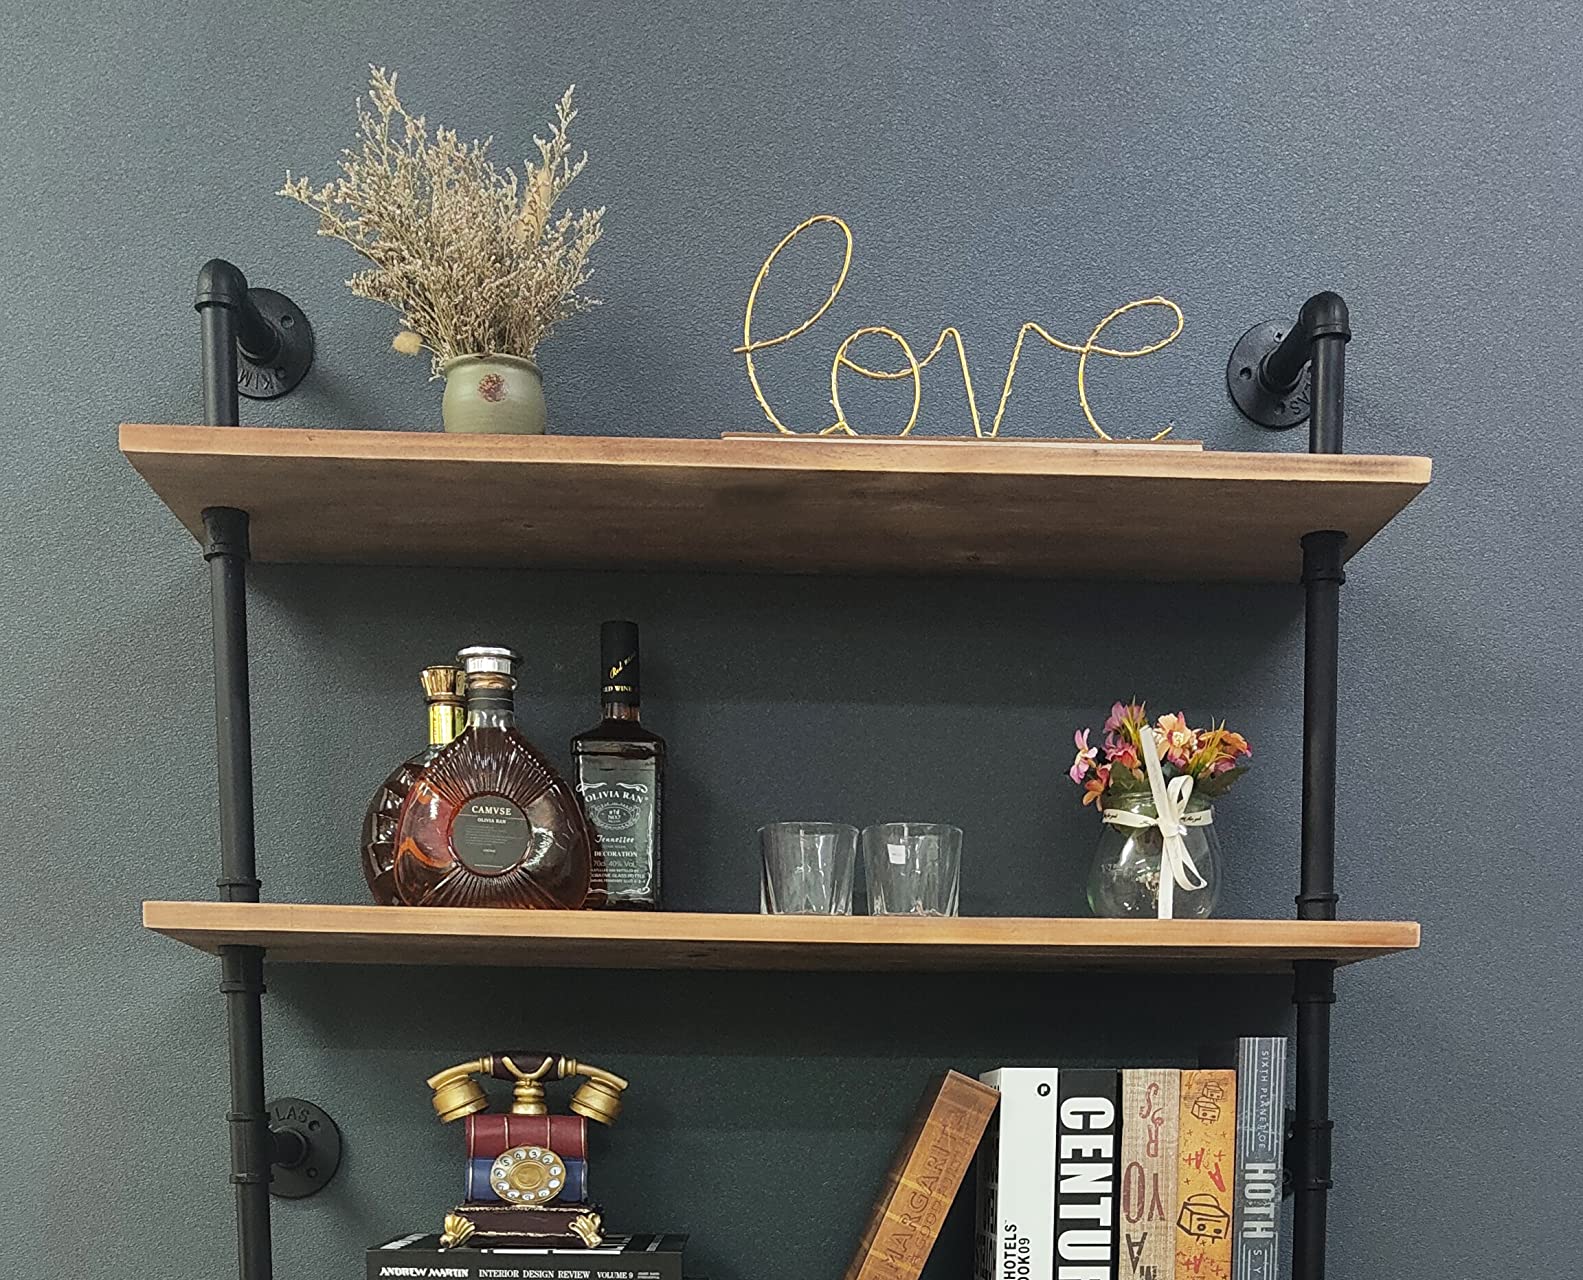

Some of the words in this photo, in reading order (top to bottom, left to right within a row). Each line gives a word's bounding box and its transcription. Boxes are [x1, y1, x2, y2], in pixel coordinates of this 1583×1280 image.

[585, 791, 620, 802] OLIVIA
[623, 791, 644, 803] RAN
[1261, 1050, 1269, 1081] SIXTH
[1243, 1162, 1276, 1238] HOTH
[1004, 1224, 1017, 1278] HOTELS
[379, 1267, 427, 1276] ANDREW
[428, 1268, 469, 1277] MARTIN
[479, 1269, 519, 1278] INTERIOR
[522, 1269, 554, 1279] DESIGN
[557, 1270, 590, 1279] REVIEW
[597, 1271, 627, 1279] VOLUME
